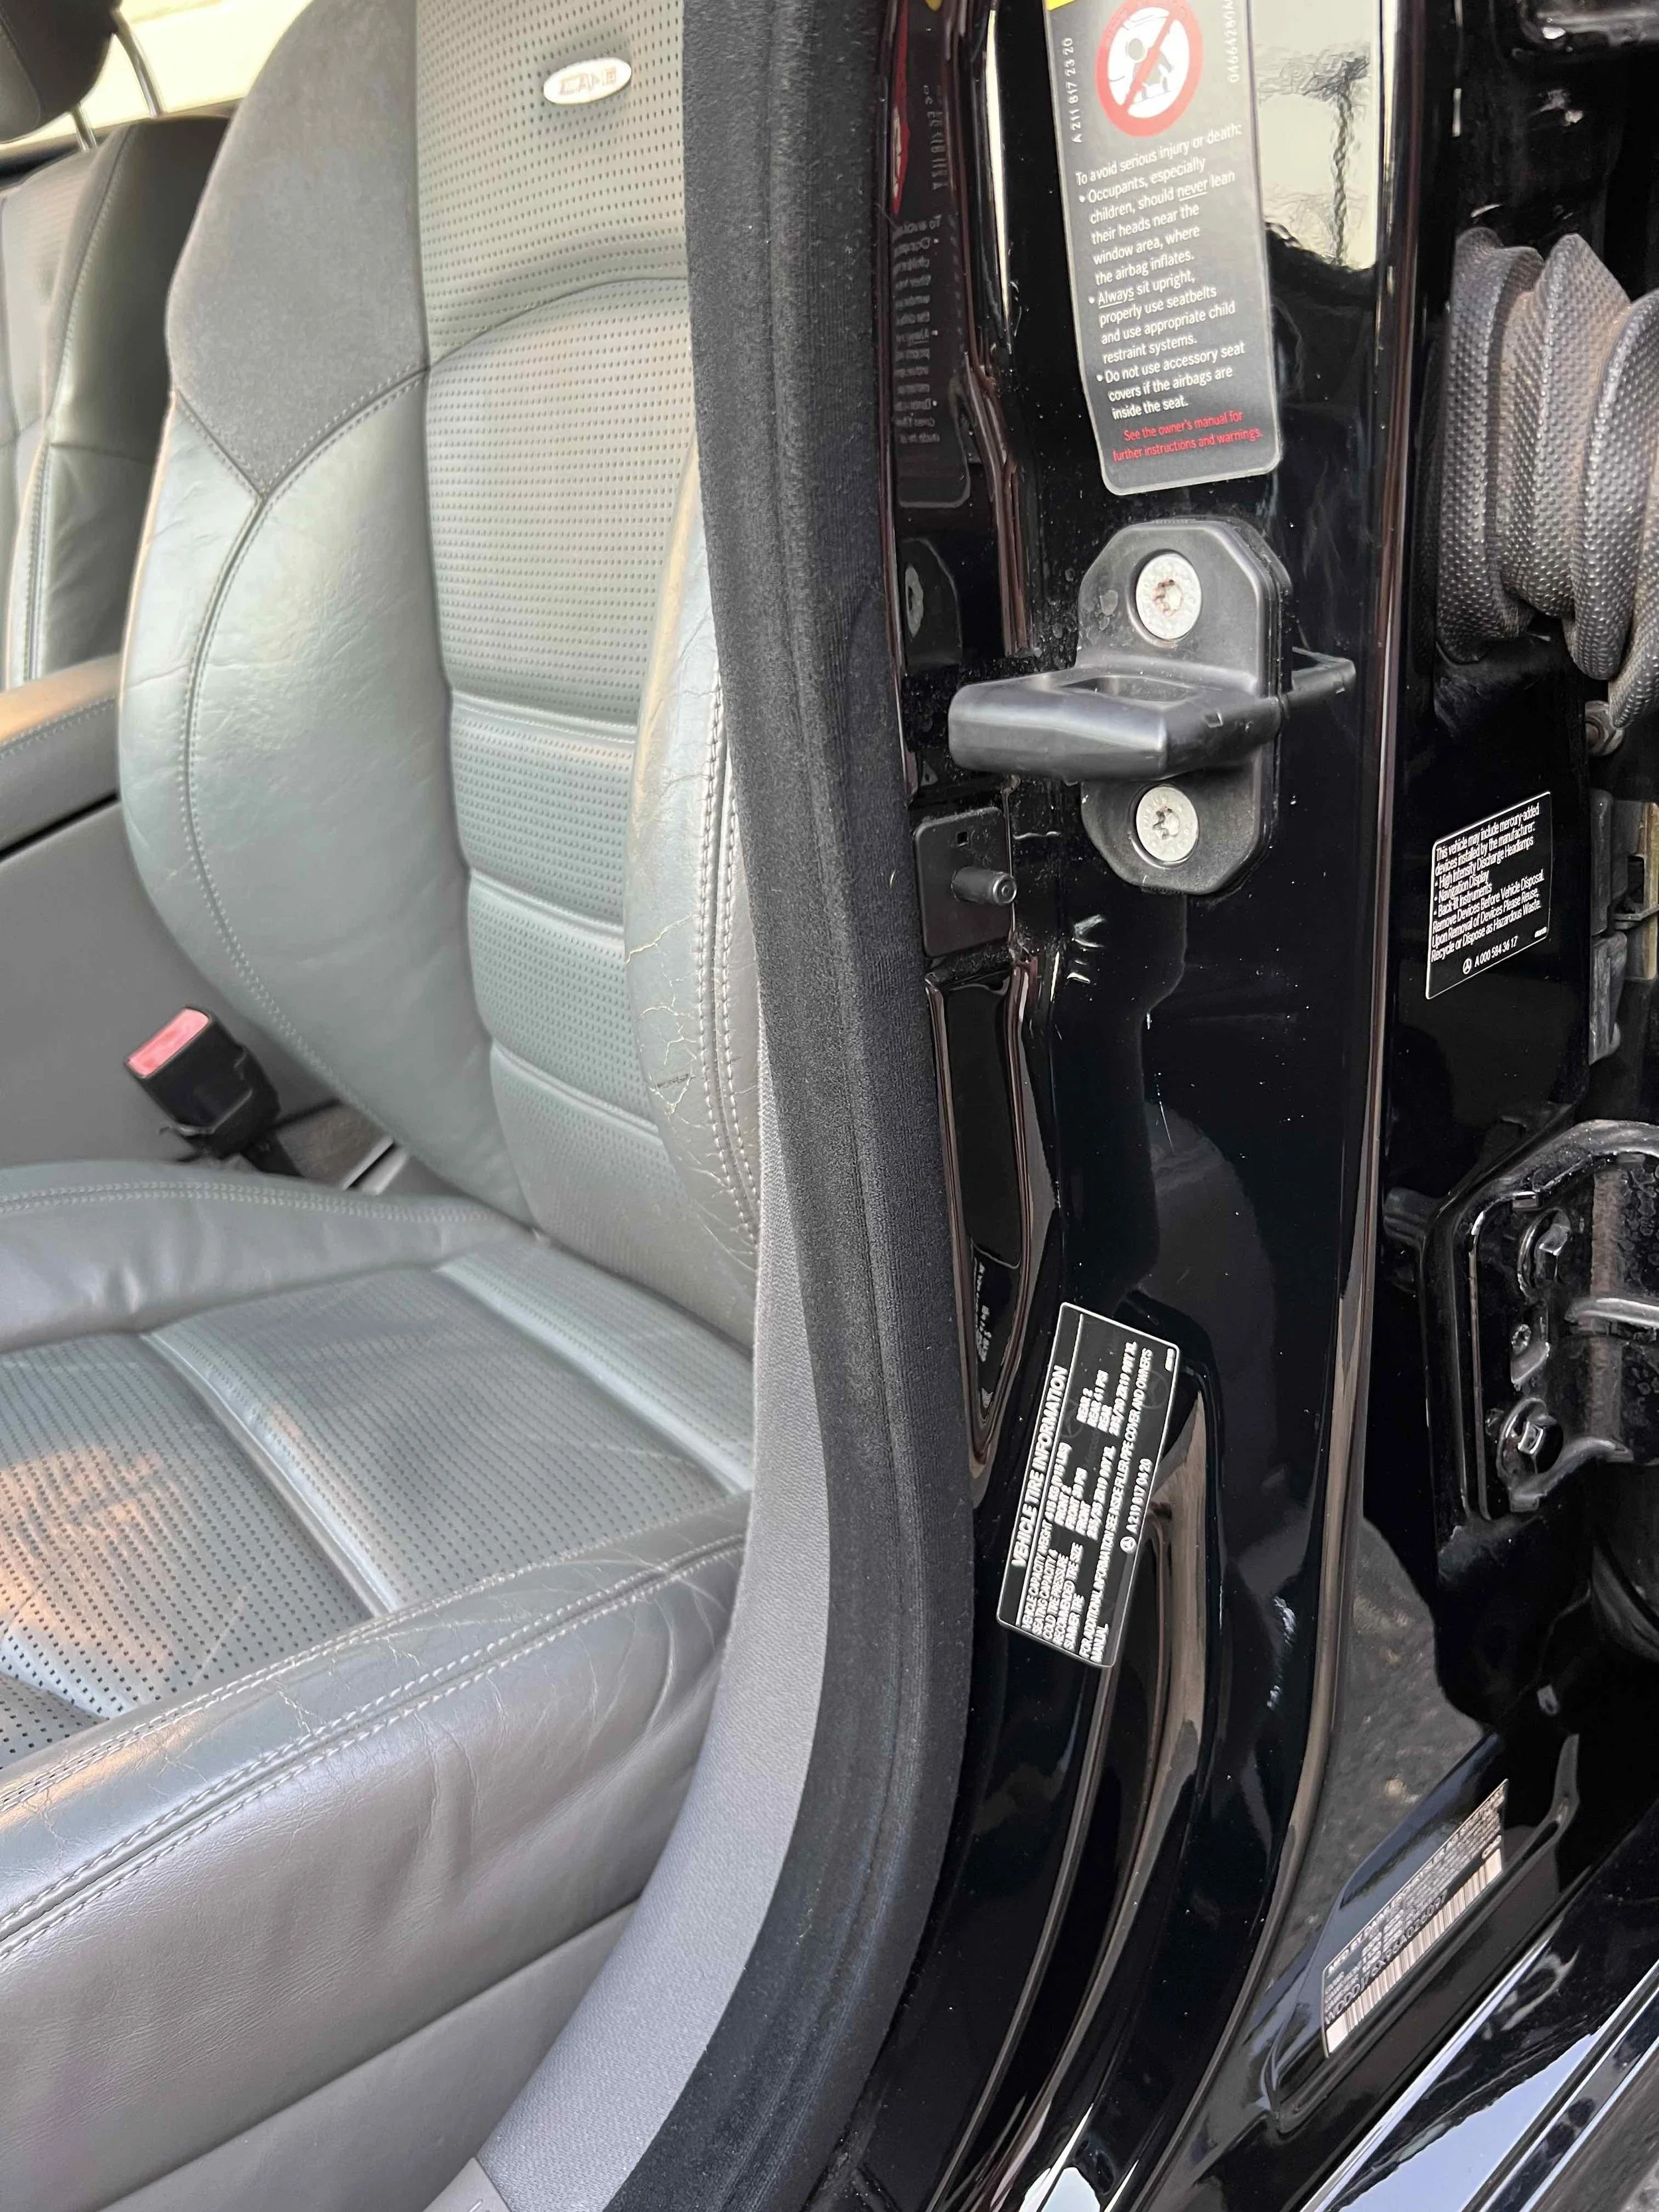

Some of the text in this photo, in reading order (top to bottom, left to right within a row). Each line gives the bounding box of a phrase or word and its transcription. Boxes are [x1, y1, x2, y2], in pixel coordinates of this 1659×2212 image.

[1062, 38, 1083, 143] A 211 817 23 20
[1074, 123, 1242, 186] To avoid serious injury or death:
[1086, 157, 1205, 202] Occupants, especially
[1088, 171, 1235, 224] children, should never lean
[1090, 204, 1199, 244] their heads near the
[1092, 226, 1200, 265] window area, where
[1094, 250, 1194, 285] the airbag inflates.
[1098, 269, 1195, 306] Always sit upright,
[1098, 286, 1216, 328] properly use seatbelts
[1101, 300, 1236, 344] and use appropriate child
[1102, 334, 1197, 364] restraint systems.
[1104, 341, 1245, 383] Do not use accessory seat
[1108, 366, 1232, 402] covers if the airbags are
[1112, 394, 1189, 419] inside the seat.
[1123, 410, 1243, 441] See the owner's manual for
[1112, 427, 1263, 461] further instructions and warnings.
[1434, 857, 1457, 876] devices
[1457, 844, 1480, 865] installed
[1479, 842, 1488, 858] by
[1488, 838, 1498, 851] the
[1435, 845, 1448, 861] This
[1448, 836, 1467, 855] vehicle
[1467, 832, 1480, 848] may
[1480, 822, 1499, 841] include
[1438, 836, 1534, 891] High Intensity Discharge Headlamps
[1438, 869, 1489, 903] Navigation Display
[1459, 882, 1492, 907] Instruments
[1431, 931, 1448, 948] Upon
[1447, 917, 1473, 940] Removal
[1473, 913, 1480, 928] of
[1479, 905, 1503, 924] Devices
[1502, 895, 1520, 913] Please
[1432, 913, 1457, 934] Remove
[1457, 902, 1480, 922] Devices
[1480, 892, 1500, 910] Before
[1500, 881, 1520, 899] Vehicle
[1430, 942, 1455, 962] Recycle
[1455, 938, 1462, 950] or
[1462, 926, 1485, 946] Dispose
[1485, 922, 1493, 934] as
[1492, 909, 1522, 930] Hazardous
[1474, 954, 1480, 968] A
[1479, 948, 1490, 964] 000
[1502, 939, 1510, 952] 36
[1510, 934, 1518, 948] 17
[1131, 1388, 1145, 1410] AND
[1124, 1409, 1140, 1441] COVER
[1011, 1365, 1067, 1566] VEHICLE TIRE INFORMATION
[1114, 1459, 1129, 1489] FILLER
[1108, 1486, 1123, 1516] INSIDE
[1037, 1519, 1052, 1554] WEIGHT
[1105, 1513, 1118, 1532] SEE
[1028, 1552, 1045, 1596] CAPACITY
[1093, 1530, 1114, 1590] INFORMATION
[1021, 1595, 1037, 1630] VEHICLE
[1031, 1598, 1047, 1635] SEATING
[1039, 1555, 1056, 1599] CAPACITY
[1042, 1554, 1068, 1639] COLD TIRE PRESSURE
[1052, 1542, 1083, 1645] RECOMMENDED TIRE SIZE
[1063, 1593, 1084, 1650] SUMMER TIRE
[1083, 1590, 1103, 1639] ADDITIONAL
[1078, 1637, 1092, 1658] FOR
